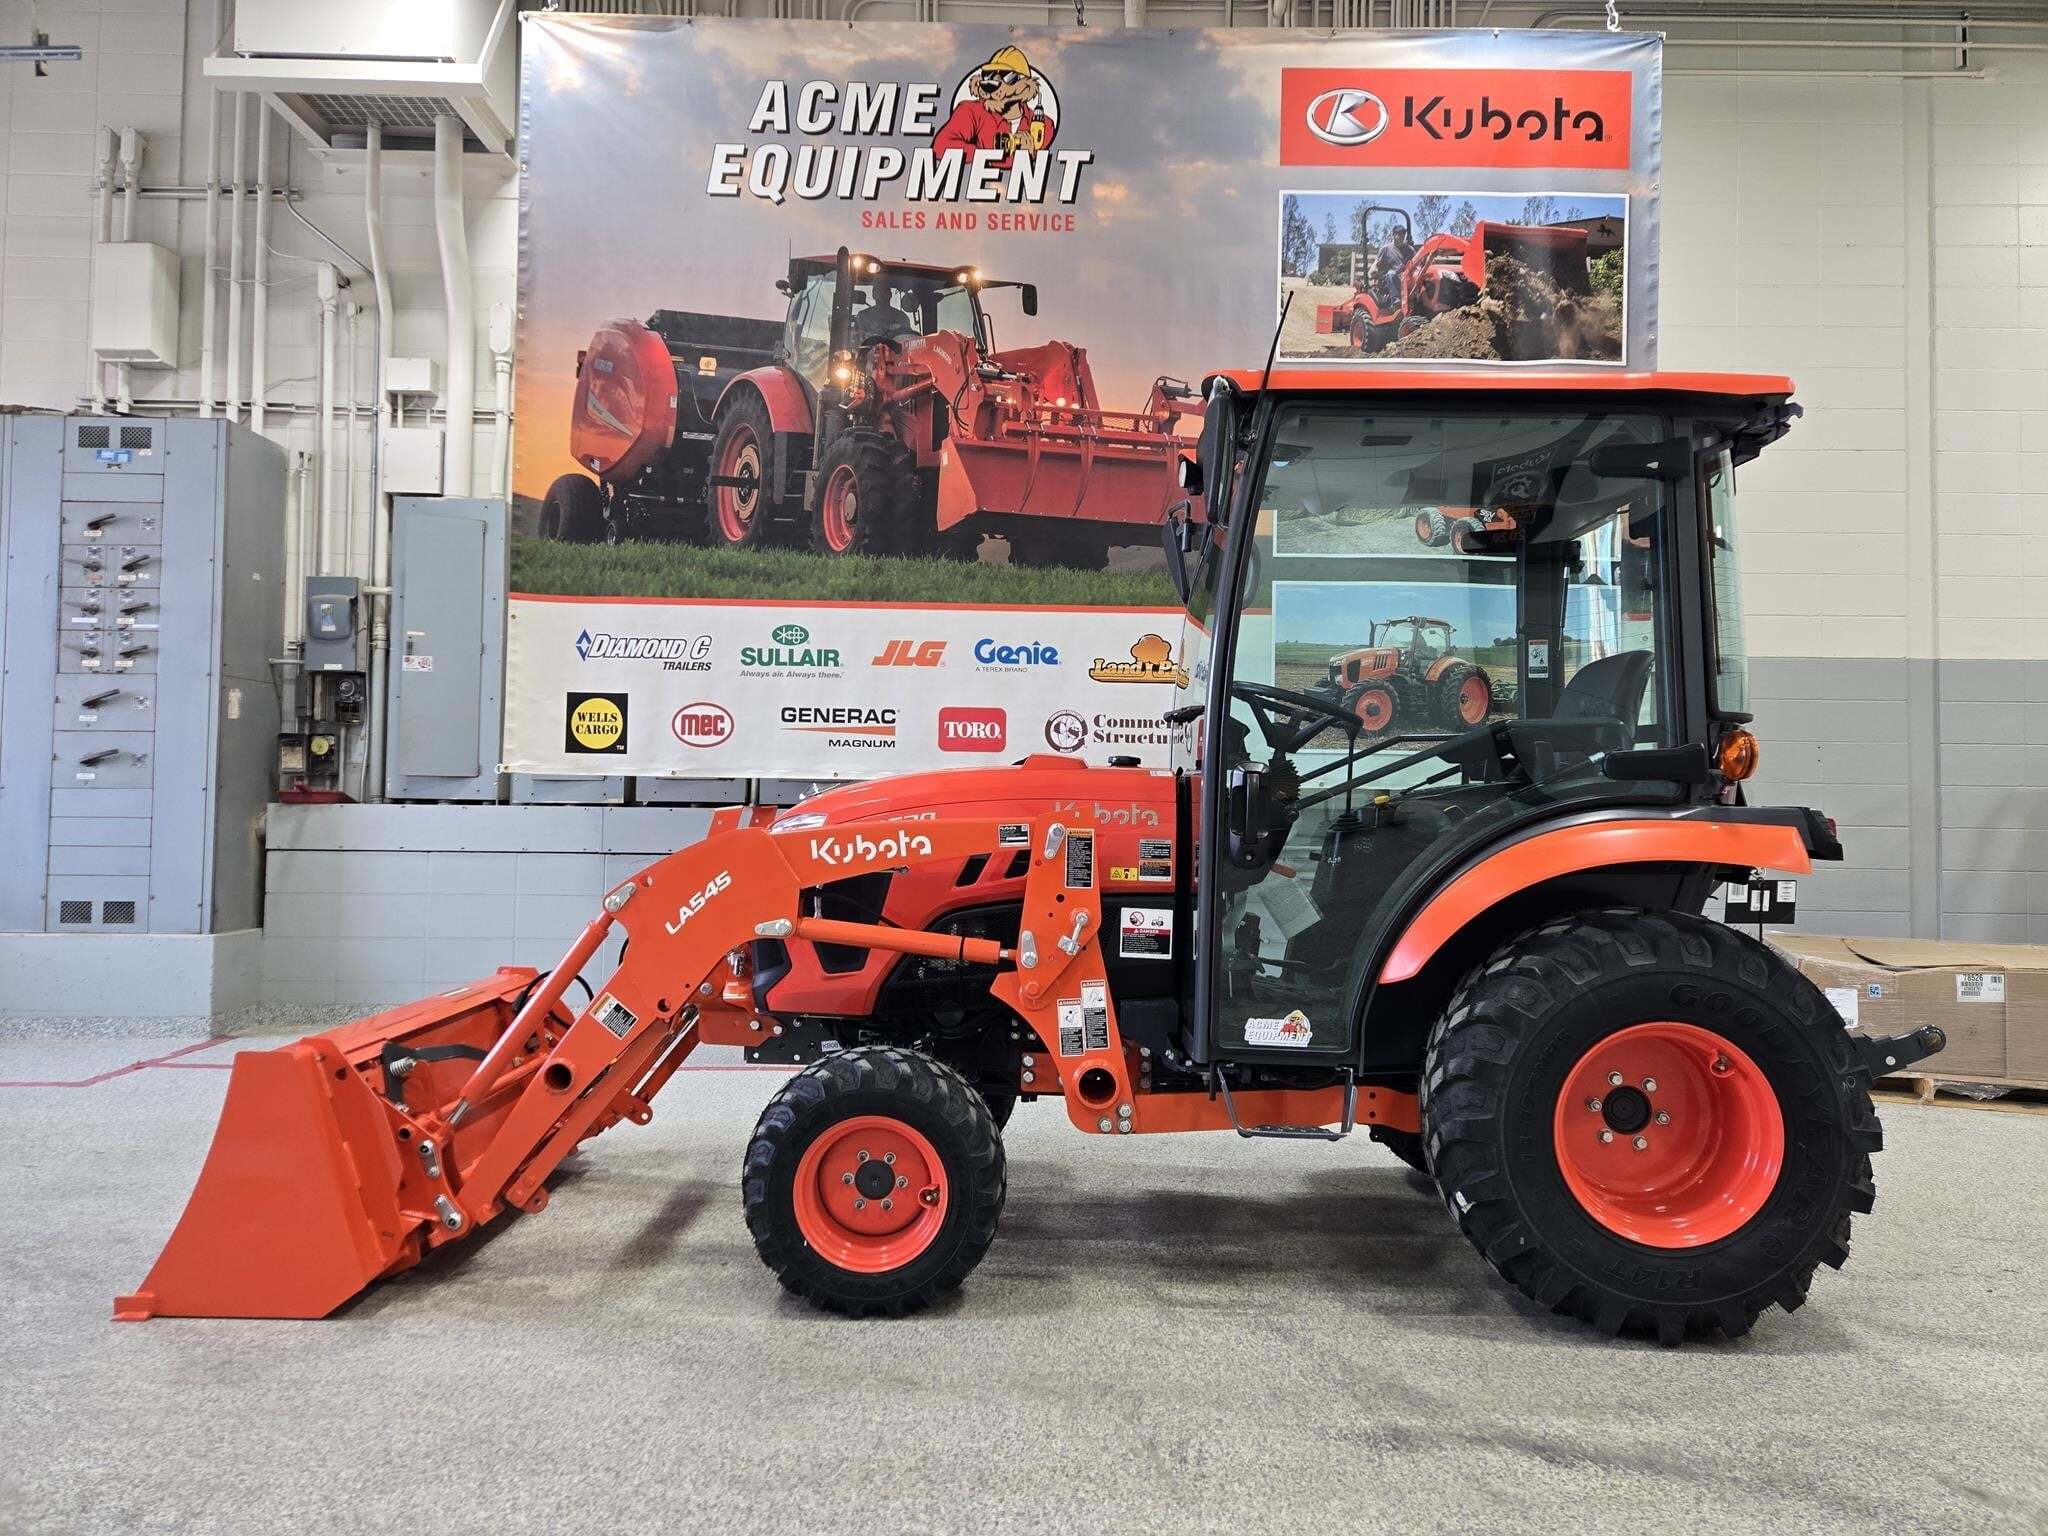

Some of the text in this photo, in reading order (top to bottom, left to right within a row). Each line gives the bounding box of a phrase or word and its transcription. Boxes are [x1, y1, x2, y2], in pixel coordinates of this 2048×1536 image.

[748, 80, 941, 137] ACME
[1404, 96, 1604, 142] Kubota
[706, 143, 1094, 206] EQUIPMENT
[862, 211, 1075, 232] SALES AND SERVICE
[588, 633, 713, 660] DIAMOND C
[740, 647, 840, 667] SULLAIR
[871, 640, 948, 666] JLG
[974, 638, 1059, 665] Genie
[663, 661, 712, 671] TRAILERS
[740, 670, 770, 678] Always
[786, 671, 816, 679] Always
[577, 711, 618, 722] WELLS
[781, 707, 896, 724] GENERAC
[576, 725, 619, 735] CARGO
[828, 740, 896, 748] MAGNUM
[810, 830, 932, 865] Kubota
[665, 870, 732, 936] LA545
